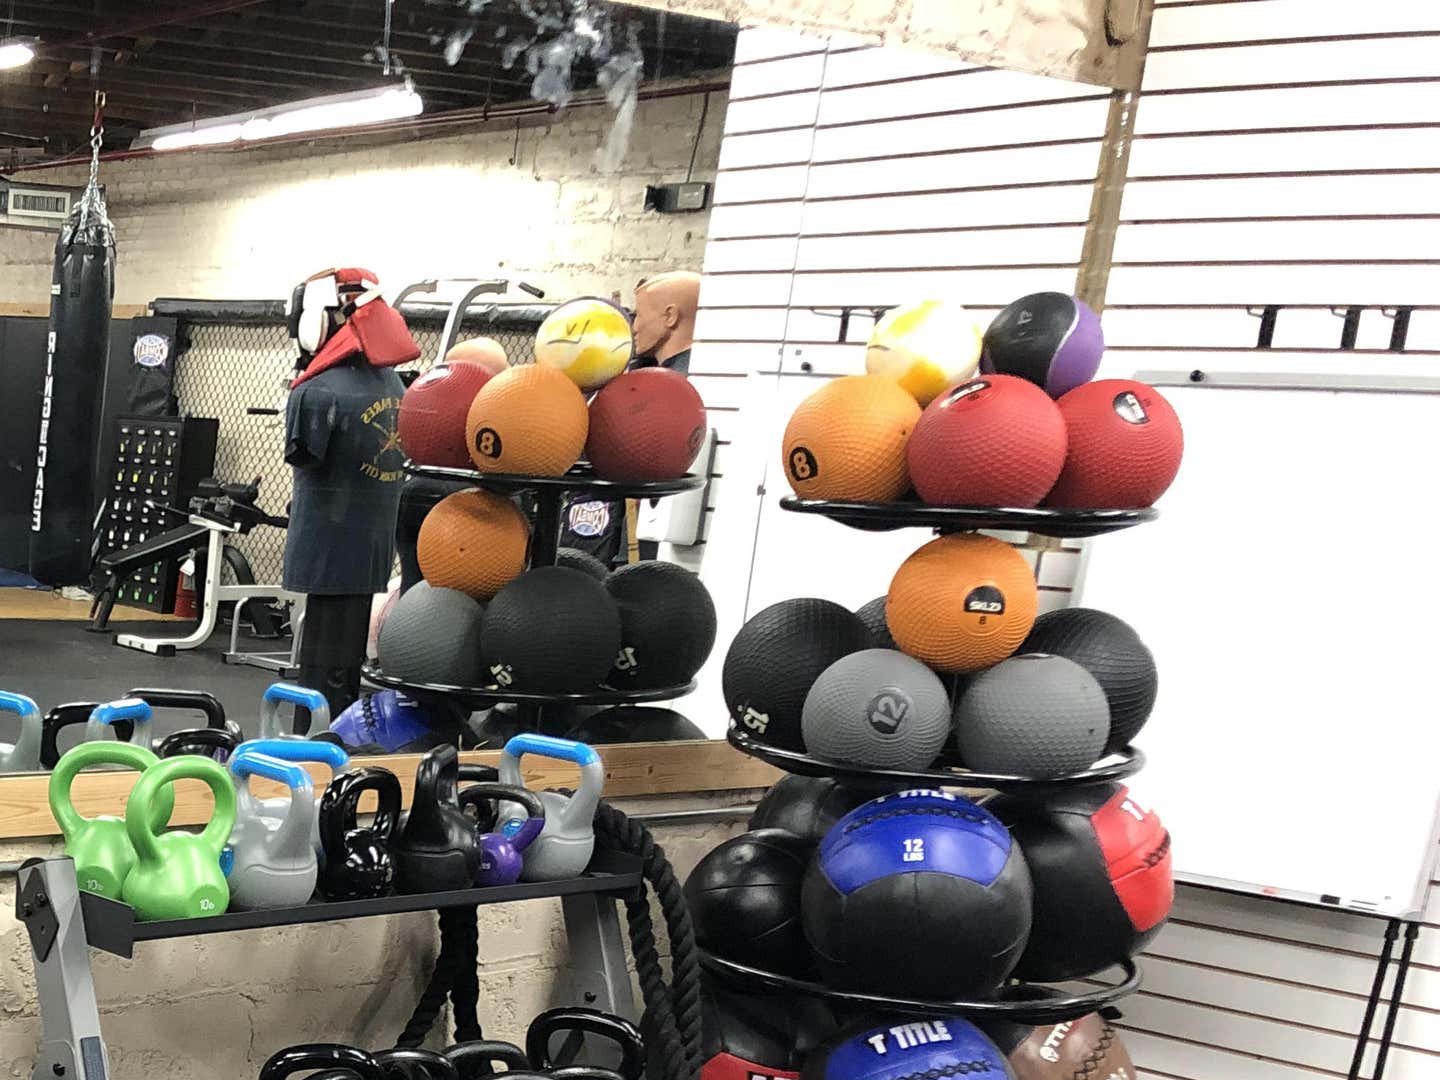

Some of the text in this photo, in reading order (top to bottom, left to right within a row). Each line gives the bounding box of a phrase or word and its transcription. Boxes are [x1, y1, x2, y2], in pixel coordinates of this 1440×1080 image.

[793, 451, 810, 478] 8
[871, 696, 907, 727] 12
[903, 838, 924, 853] 12
[903, 853, 924, 862] LBS
[889, 1020, 953, 1049] TITLE
